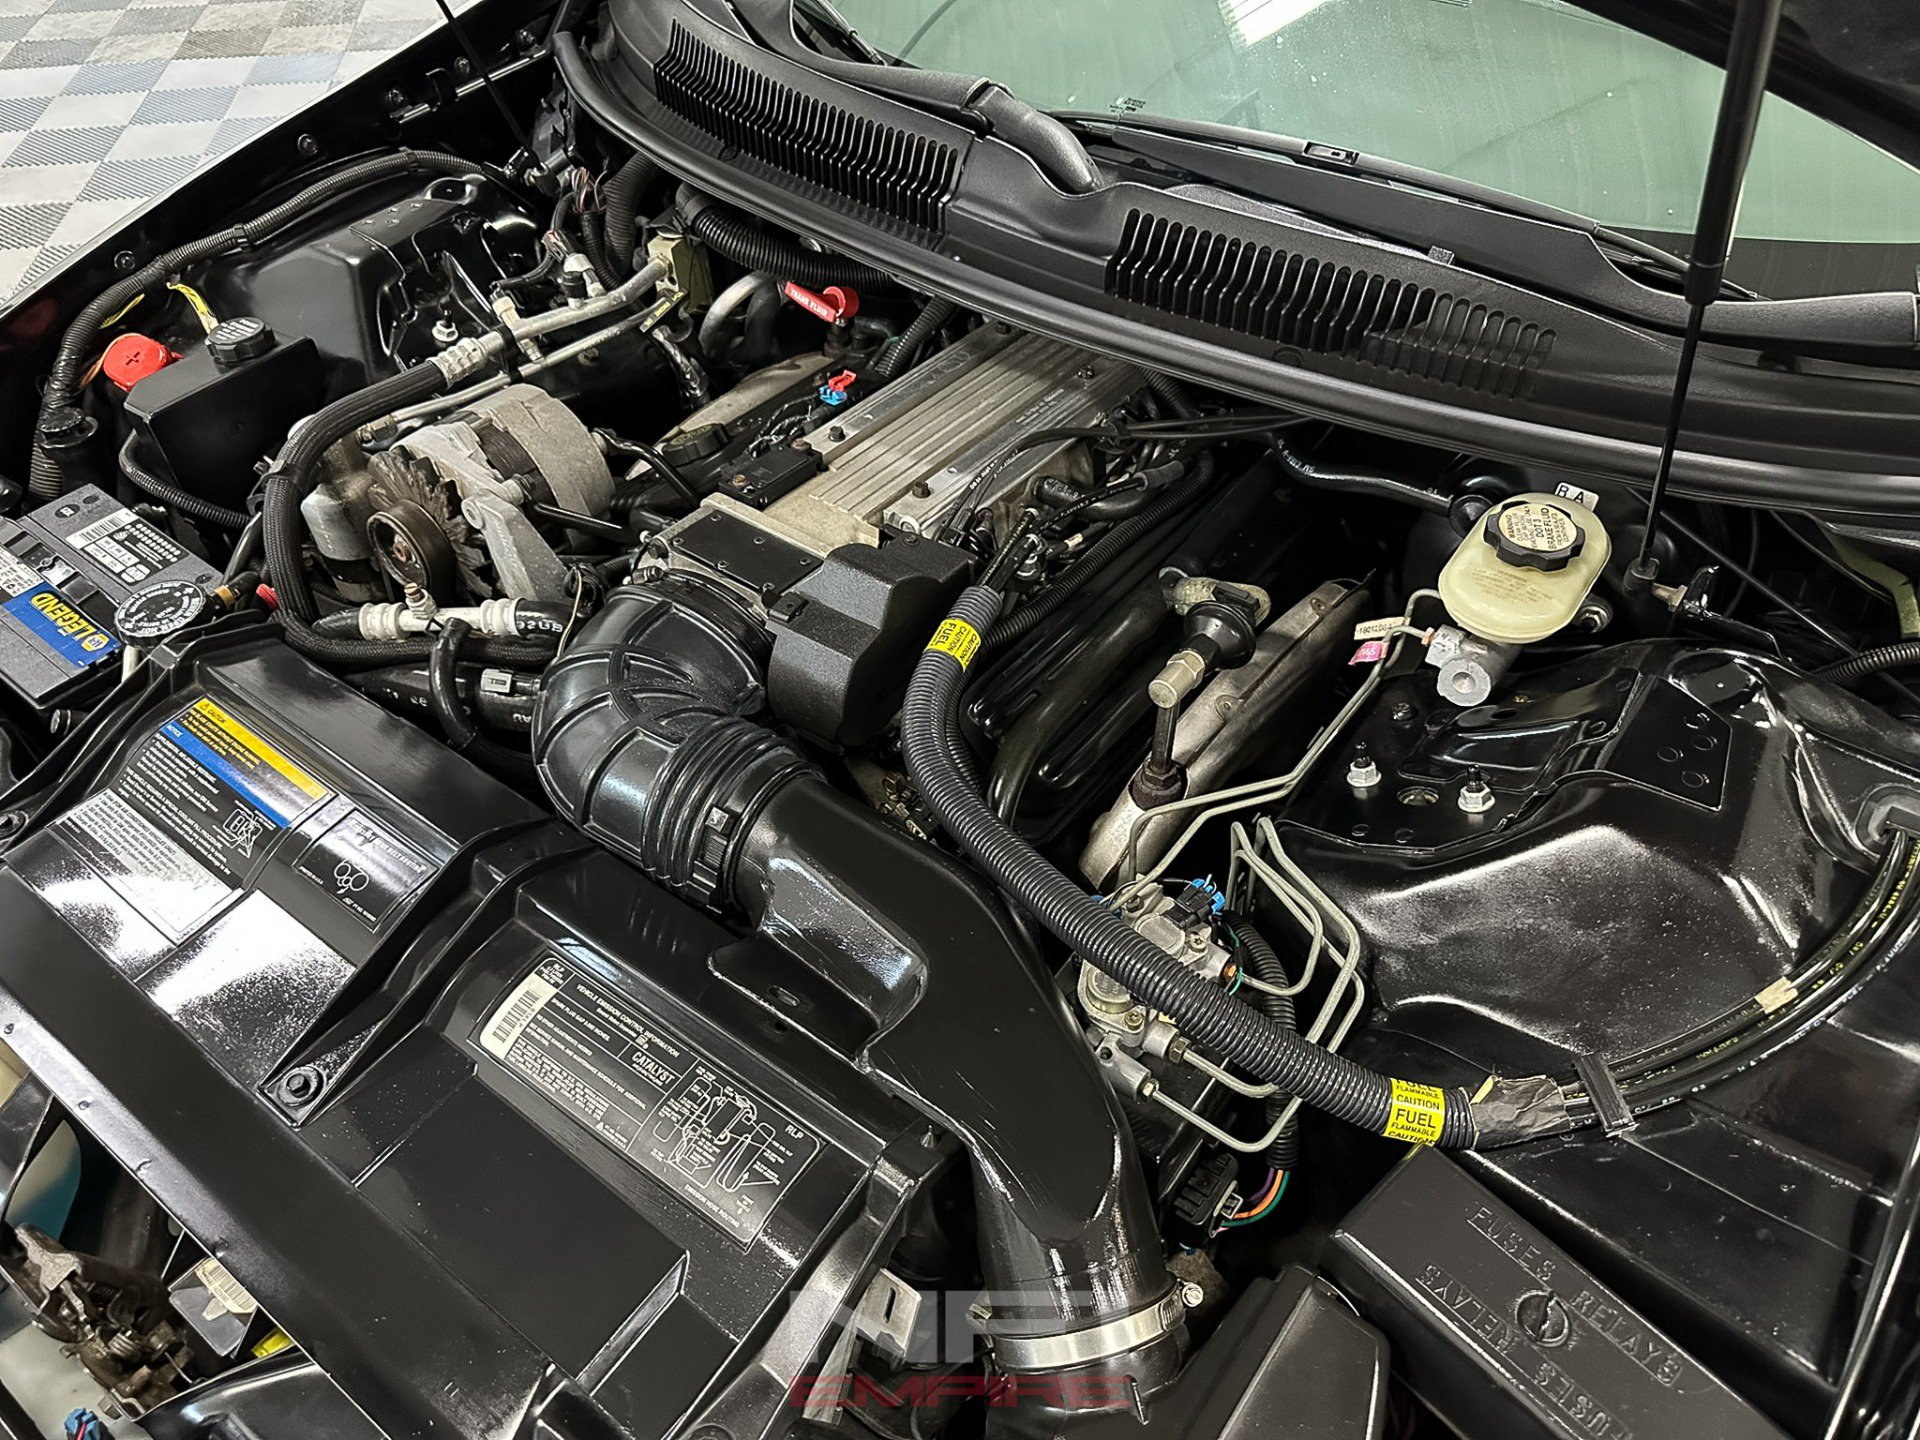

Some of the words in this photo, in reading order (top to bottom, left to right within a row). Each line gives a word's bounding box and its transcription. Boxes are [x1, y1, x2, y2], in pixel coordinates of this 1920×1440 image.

[1573, 488, 1585, 504] A
[1506, 514, 1515, 538] WARNING
[1541, 506, 1552, 526] FLUID
[1533, 523, 1544, 537] DOT
[1545, 527, 1556, 549] BRAKE
[31, 592, 95, 639] LEGEND
[935, 622, 957, 647] FUEL
[948, 625, 968, 652] CAUTION
[207, 708, 226, 723] CAUTION
[166, 724, 183, 738] NOTICE
[132, 773, 147, 786] VEHICLE
[145, 784, 163, 799] REQUIRES
[164, 799, 179, 812] SPECIAL
[176, 810, 195, 825] COOLANT
[552, 963, 565, 972] RLP
[575, 984, 598, 1001] VEHICLE
[595, 998, 621, 1017] EMISSION
[619, 1013, 645, 1033] CONTROL
[643, 1030, 680, 1058] INFORMATION
[535, 1027, 552, 1040] SERVICE
[631, 1051, 675, 1084] CATALYST
[1396, 1094, 1440, 1110] CAUTION
[1395, 1108, 1436, 1129] FUEL
[784, 1125, 804, 1140] RLP
[1391, 1122, 1437, 1138] FLAMMABLE
[683, 1184, 710, 1204] EMISSION
[707, 1201, 721, 1212] HOSE
[718, 1209, 741, 1227] ROUTING
[1469, 1205, 1557, 1281] FUSES
[1418, 1263, 1519, 1355] RELAYS
[1570, 1289, 1684, 1384] RELAYS
